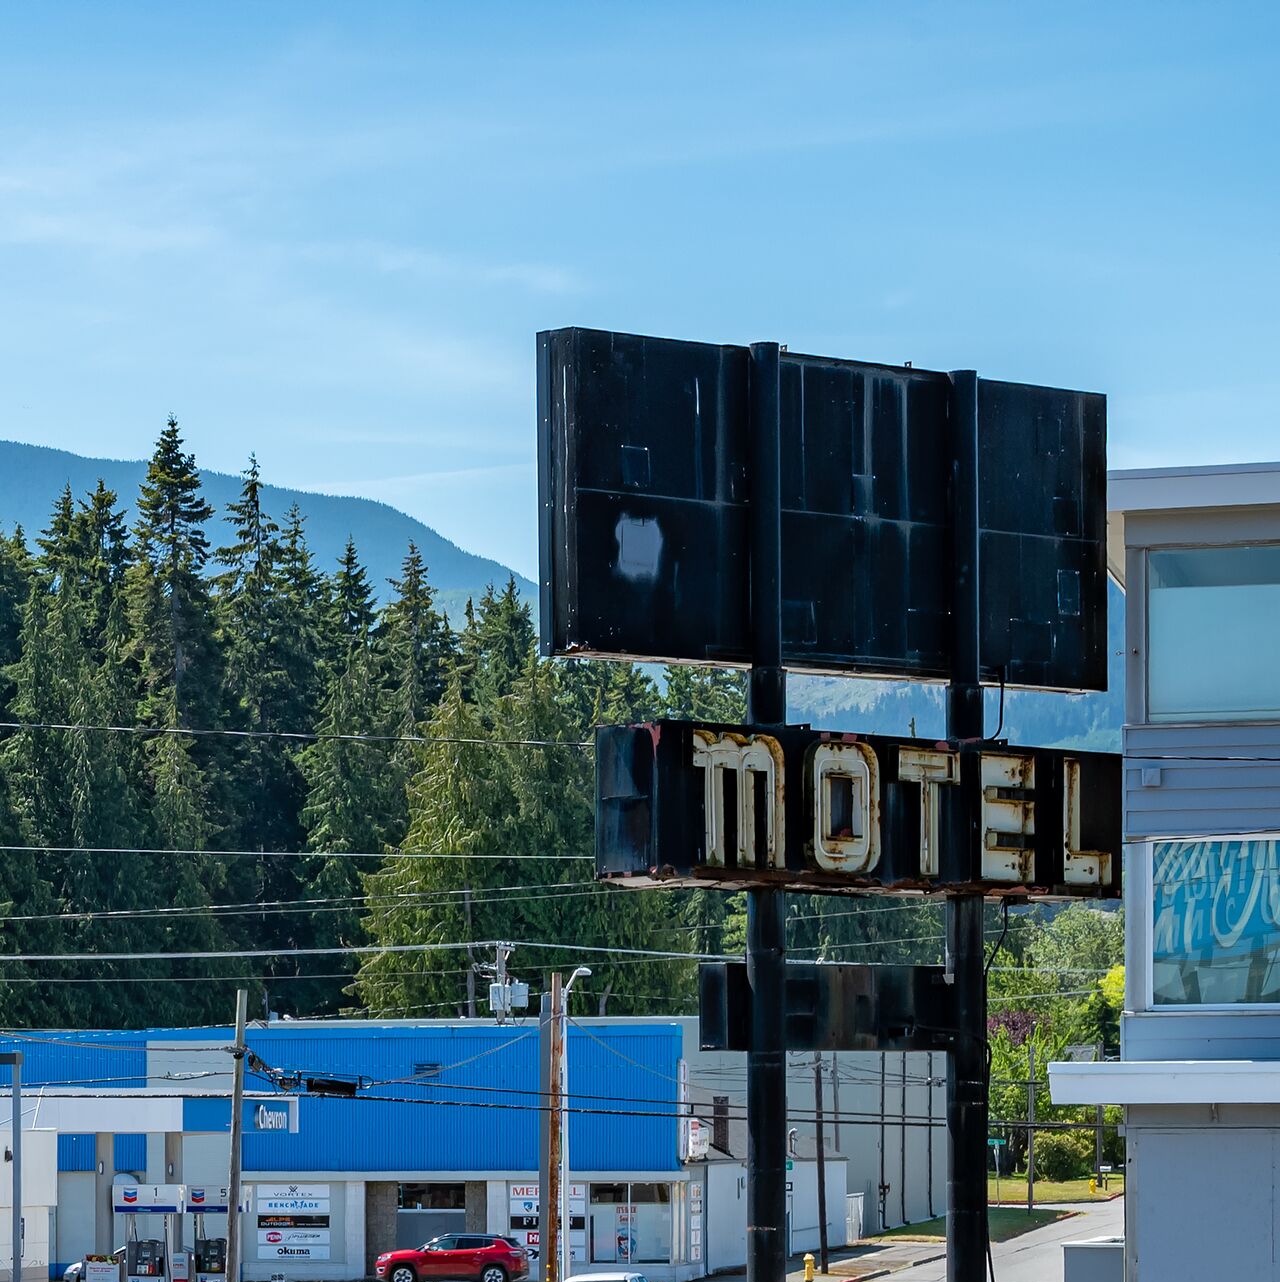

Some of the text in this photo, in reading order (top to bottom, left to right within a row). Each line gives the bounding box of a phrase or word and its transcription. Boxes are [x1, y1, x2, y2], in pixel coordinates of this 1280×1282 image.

[692, 729, 1112, 885] MOTEL
[259, 1104, 287, 1129] Chevron
[220, 1188, 227, 1197] 5
[277, 1246, 310, 1255] okuma
